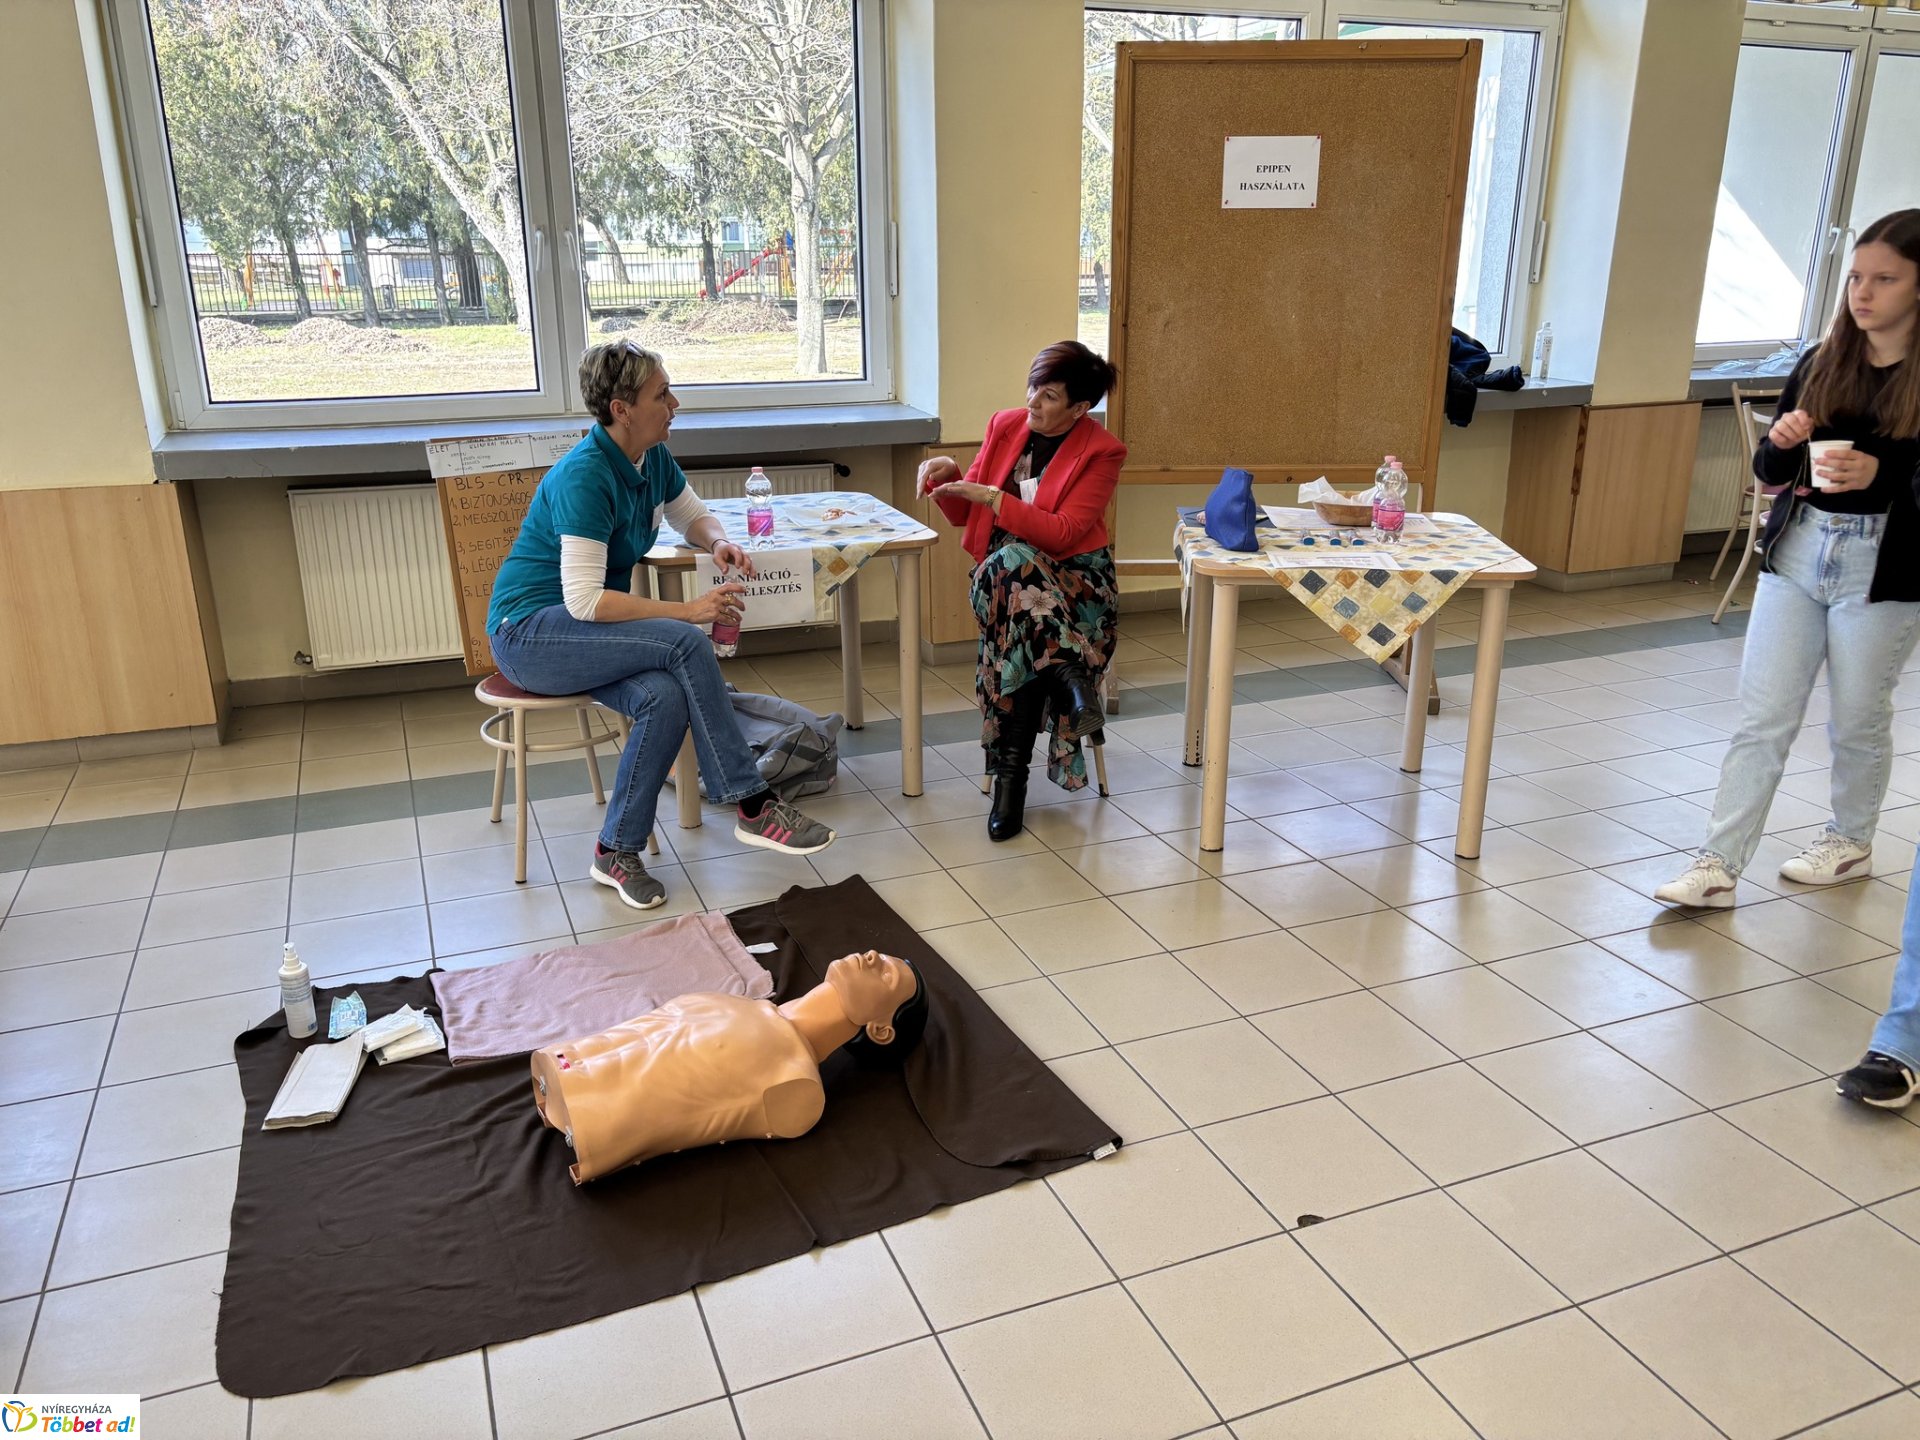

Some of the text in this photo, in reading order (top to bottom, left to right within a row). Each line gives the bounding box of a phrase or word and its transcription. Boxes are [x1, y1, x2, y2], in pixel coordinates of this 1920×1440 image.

[1256, 164, 1292, 173] EPIPEN
[1239, 180, 1306, 191] HASZNÁLATA
[454, 476, 484, 491] BLS
[497, 472, 524, 487] CPR
[463, 506, 529, 527] MEGSZOLÍTÁ
[468, 534, 516, 552] SEGITSÉ
[471, 556, 509, 573] LÉGUT
